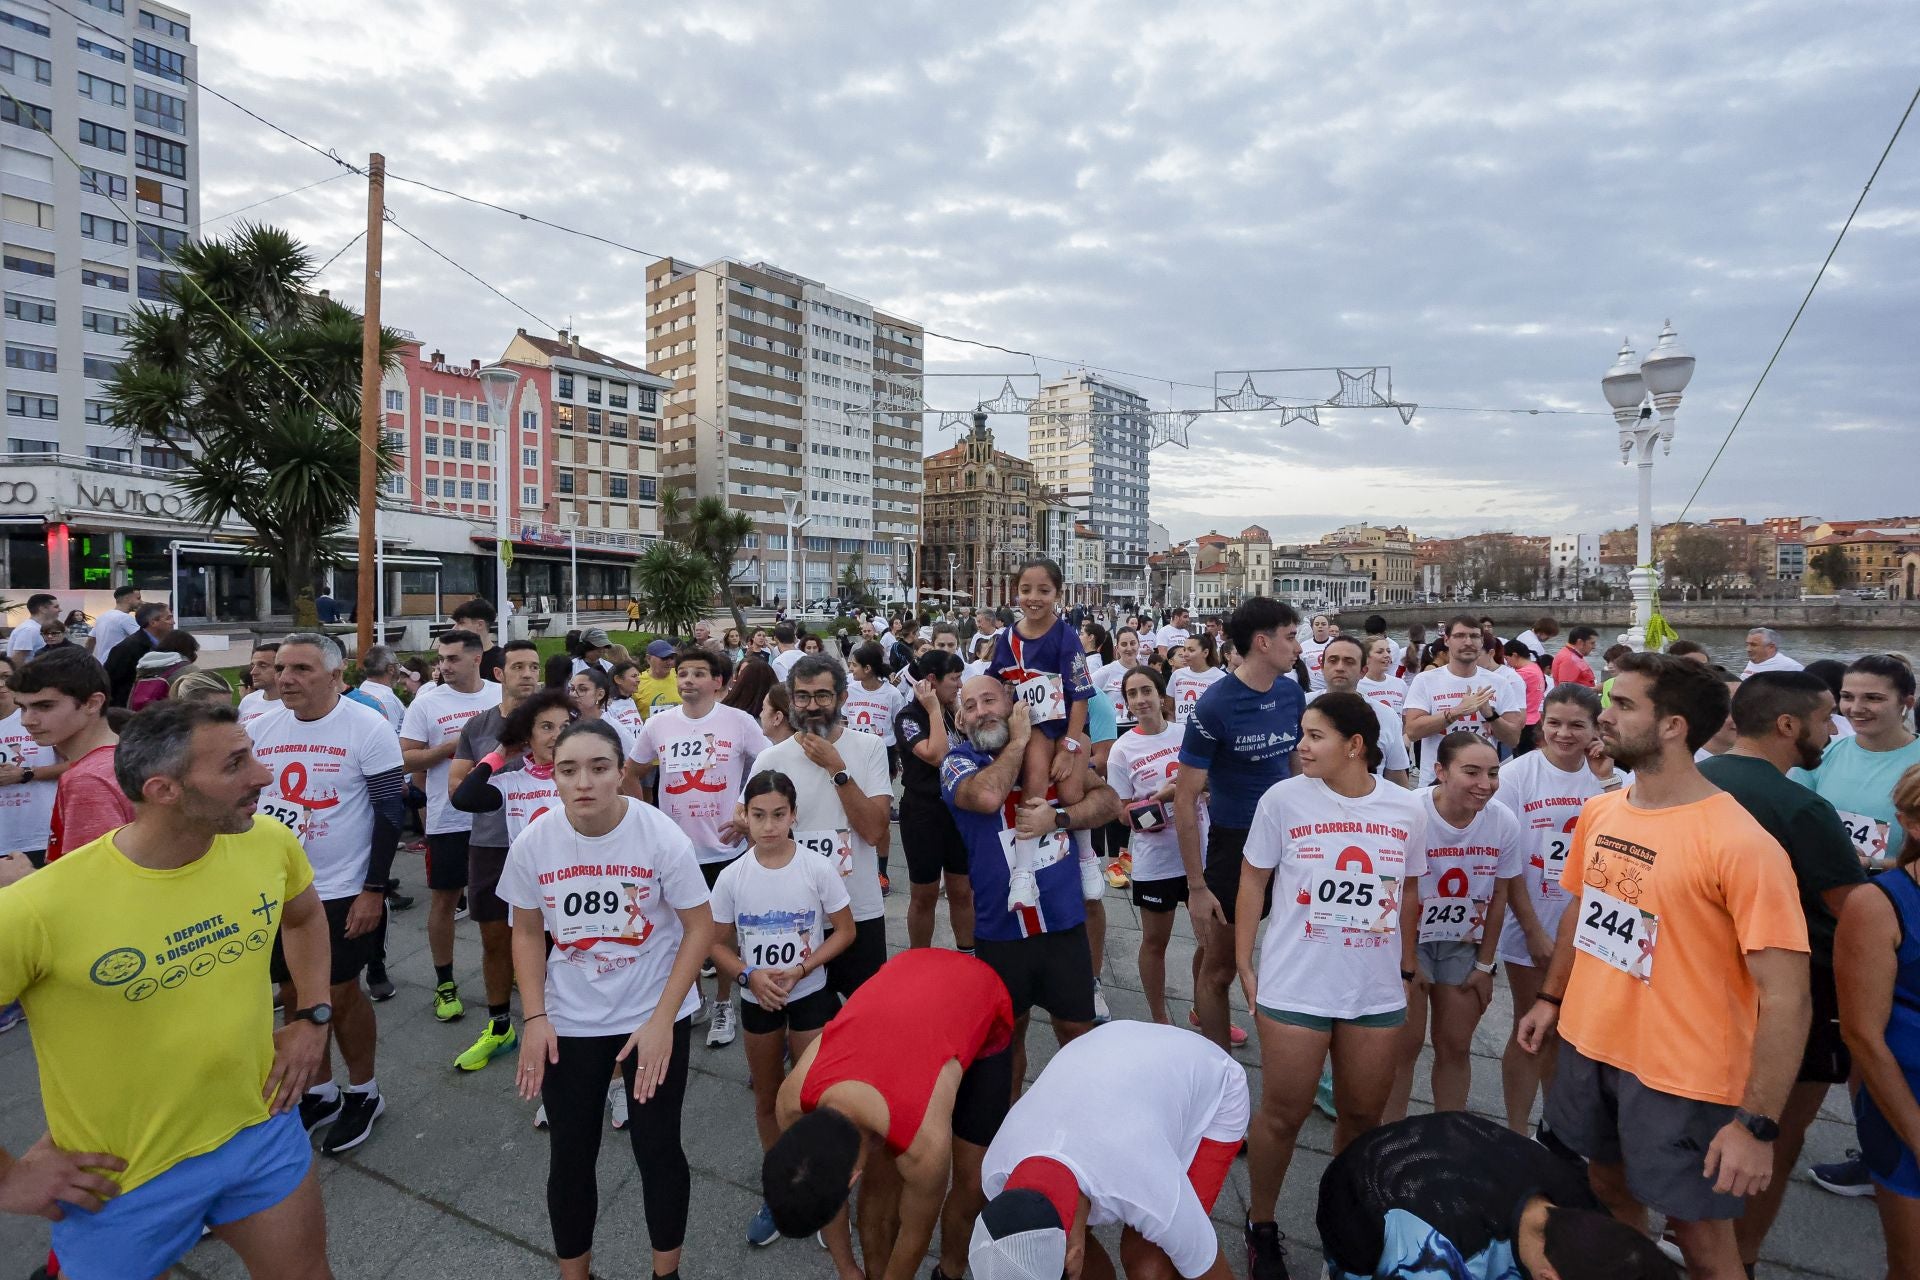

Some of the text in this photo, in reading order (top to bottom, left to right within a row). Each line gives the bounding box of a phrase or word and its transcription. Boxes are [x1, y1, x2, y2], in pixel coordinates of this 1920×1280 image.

[256, 744, 347, 757] XXIV CARRERA ANTI-SIDA
[671, 740, 702, 757] 132
[1132, 758, 1147, 772] XXIV
[1146, 748, 1172, 762] CARRERA
[1524, 797, 1582, 813] XXIV CARRERA
[1289, 825, 1311, 839] XXIV
[1315, 822, 1362, 834] CARRERA
[1428, 847, 1464, 858] CARRERA
[557, 865, 602, 880] CARRERA
[606, 865, 654, 879] ANTI-SIDA
[1318, 880, 1374, 906] 025
[564, 891, 618, 917] 089
[1426, 905, 1466, 924] 243
[165, 914, 224, 945] 1 DEPORTE
[1585, 901, 1635, 944] 244
[156, 923, 240, 965] 5 DISCIPLINAS
[752, 942, 796, 966] 160
